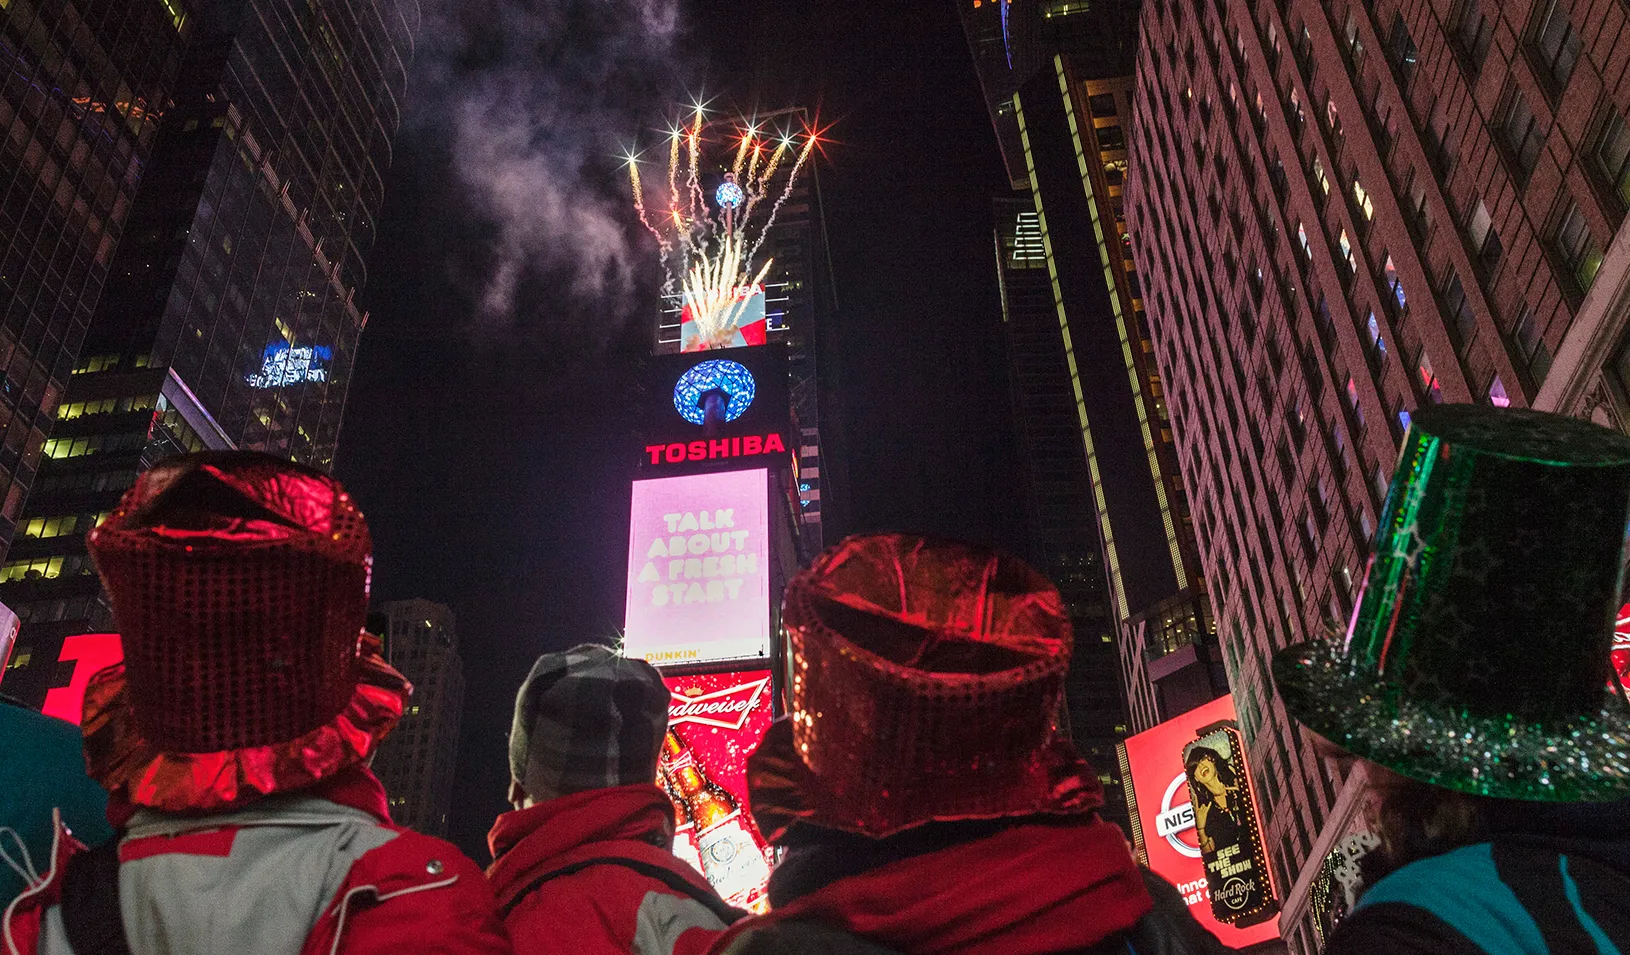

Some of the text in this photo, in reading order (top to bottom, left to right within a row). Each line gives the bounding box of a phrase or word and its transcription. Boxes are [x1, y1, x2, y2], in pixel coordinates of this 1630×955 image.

[646, 433, 785, 465] TOSHIBA
[663, 508, 735, 533] TALK
[647, 530, 749, 559] ABOUT
[637, 553, 757, 583] A FRESH
[652, 578, 743, 606] START
[645, 649, 701, 662] DUNKIN'
[668, 698, 760, 717] udweiser
[1164, 808, 1194, 830] NIS
[1216, 843, 1241, 859] SEE
[1207, 857, 1231, 873] THE
[1220, 859, 1252, 879] SHOW
[1177, 878, 1208, 895] Inno
[1214, 884, 1235, 902] Hard
[1235, 879, 1256, 895] Rock
[1231, 897, 1243, 905] CAFE
